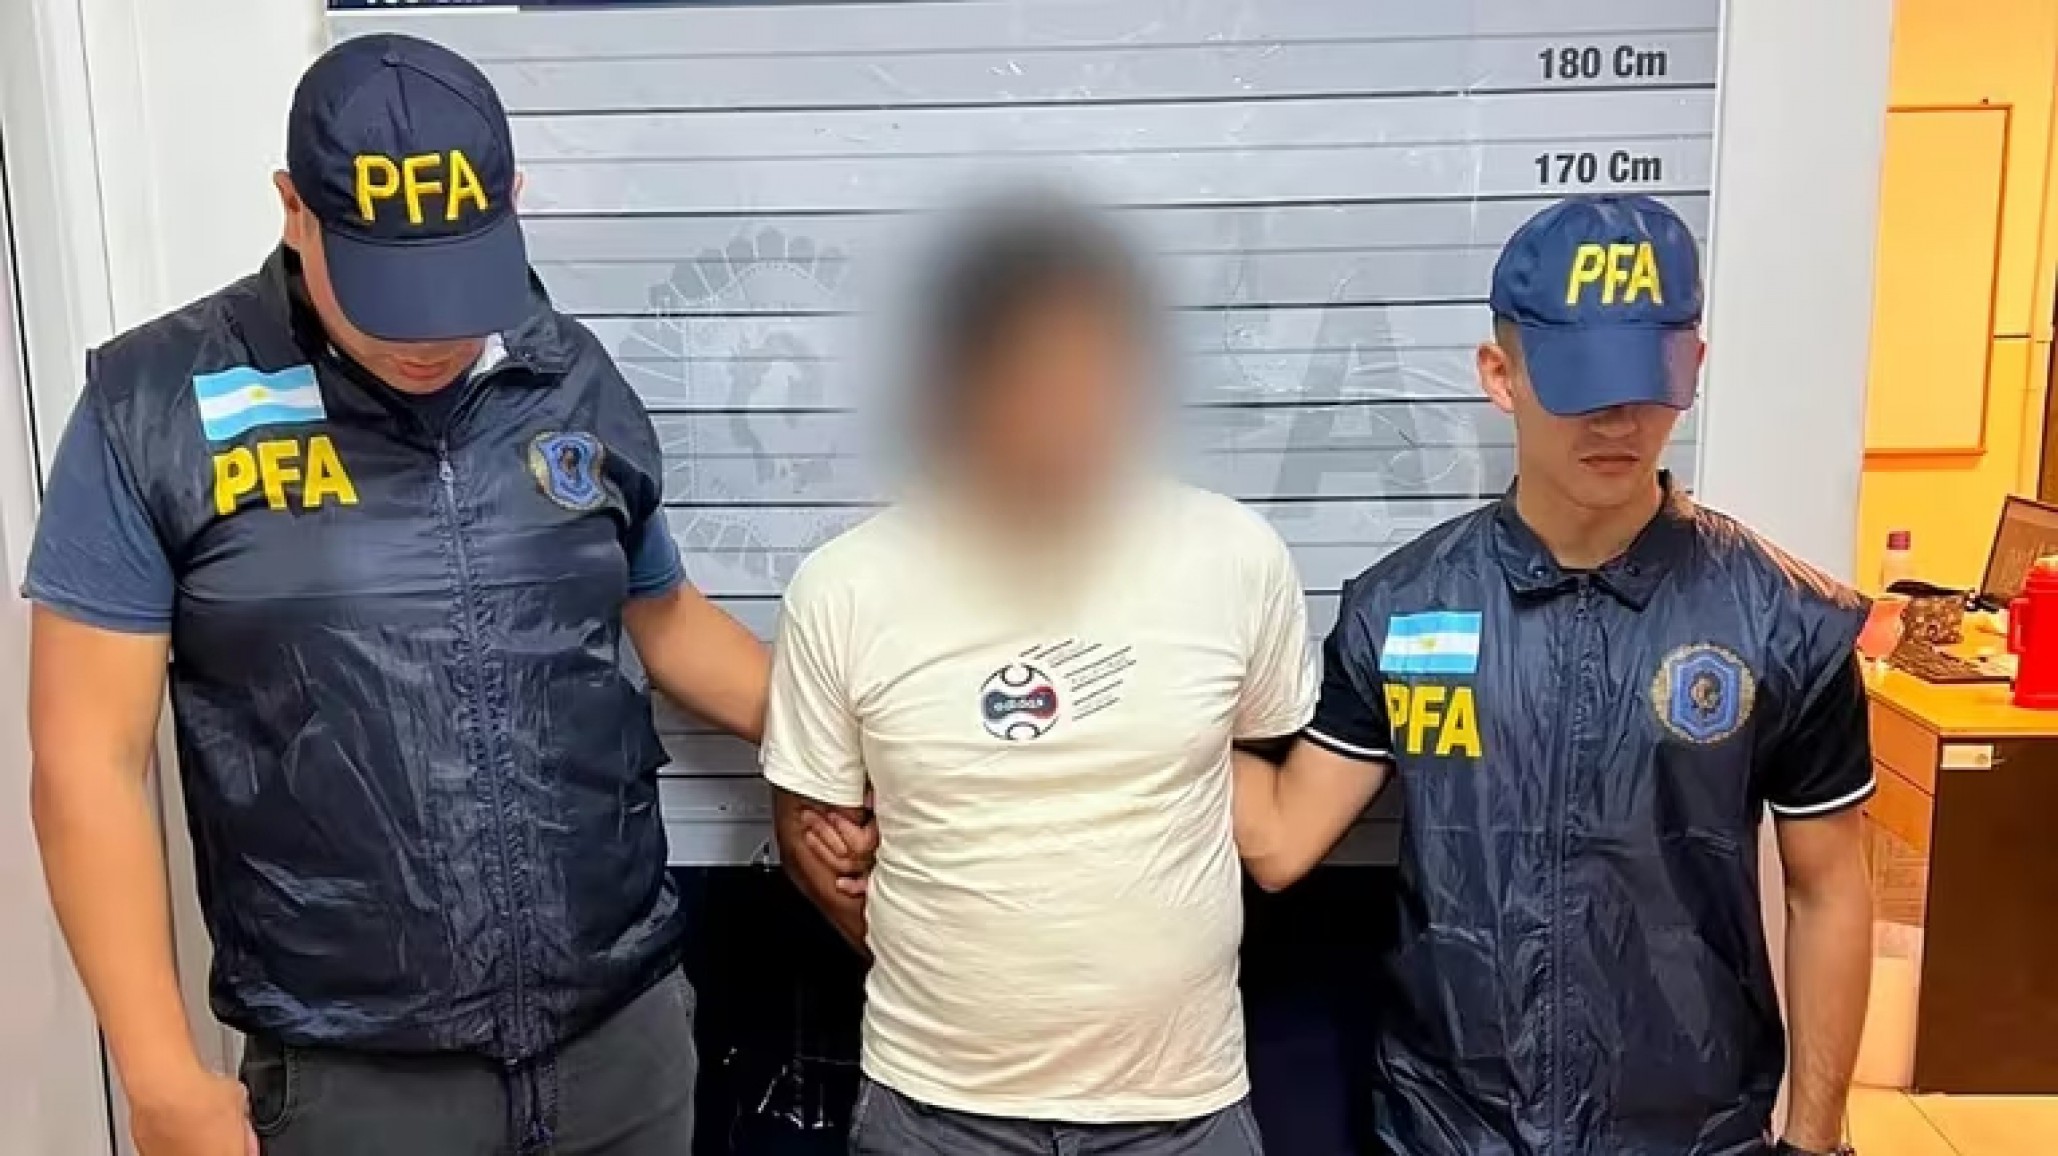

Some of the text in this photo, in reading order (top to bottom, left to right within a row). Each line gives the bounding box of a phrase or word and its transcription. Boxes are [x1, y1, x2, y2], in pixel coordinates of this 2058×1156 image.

[1538, 45, 1668, 79] 180 Cm
[354, 150, 488, 224] PFA
[1535, 150, 1662, 184] 170 Cm
[1566, 241, 1663, 305] PFA
[213, 435, 359, 515] PFA
[1383, 684, 1483, 757] PFA
